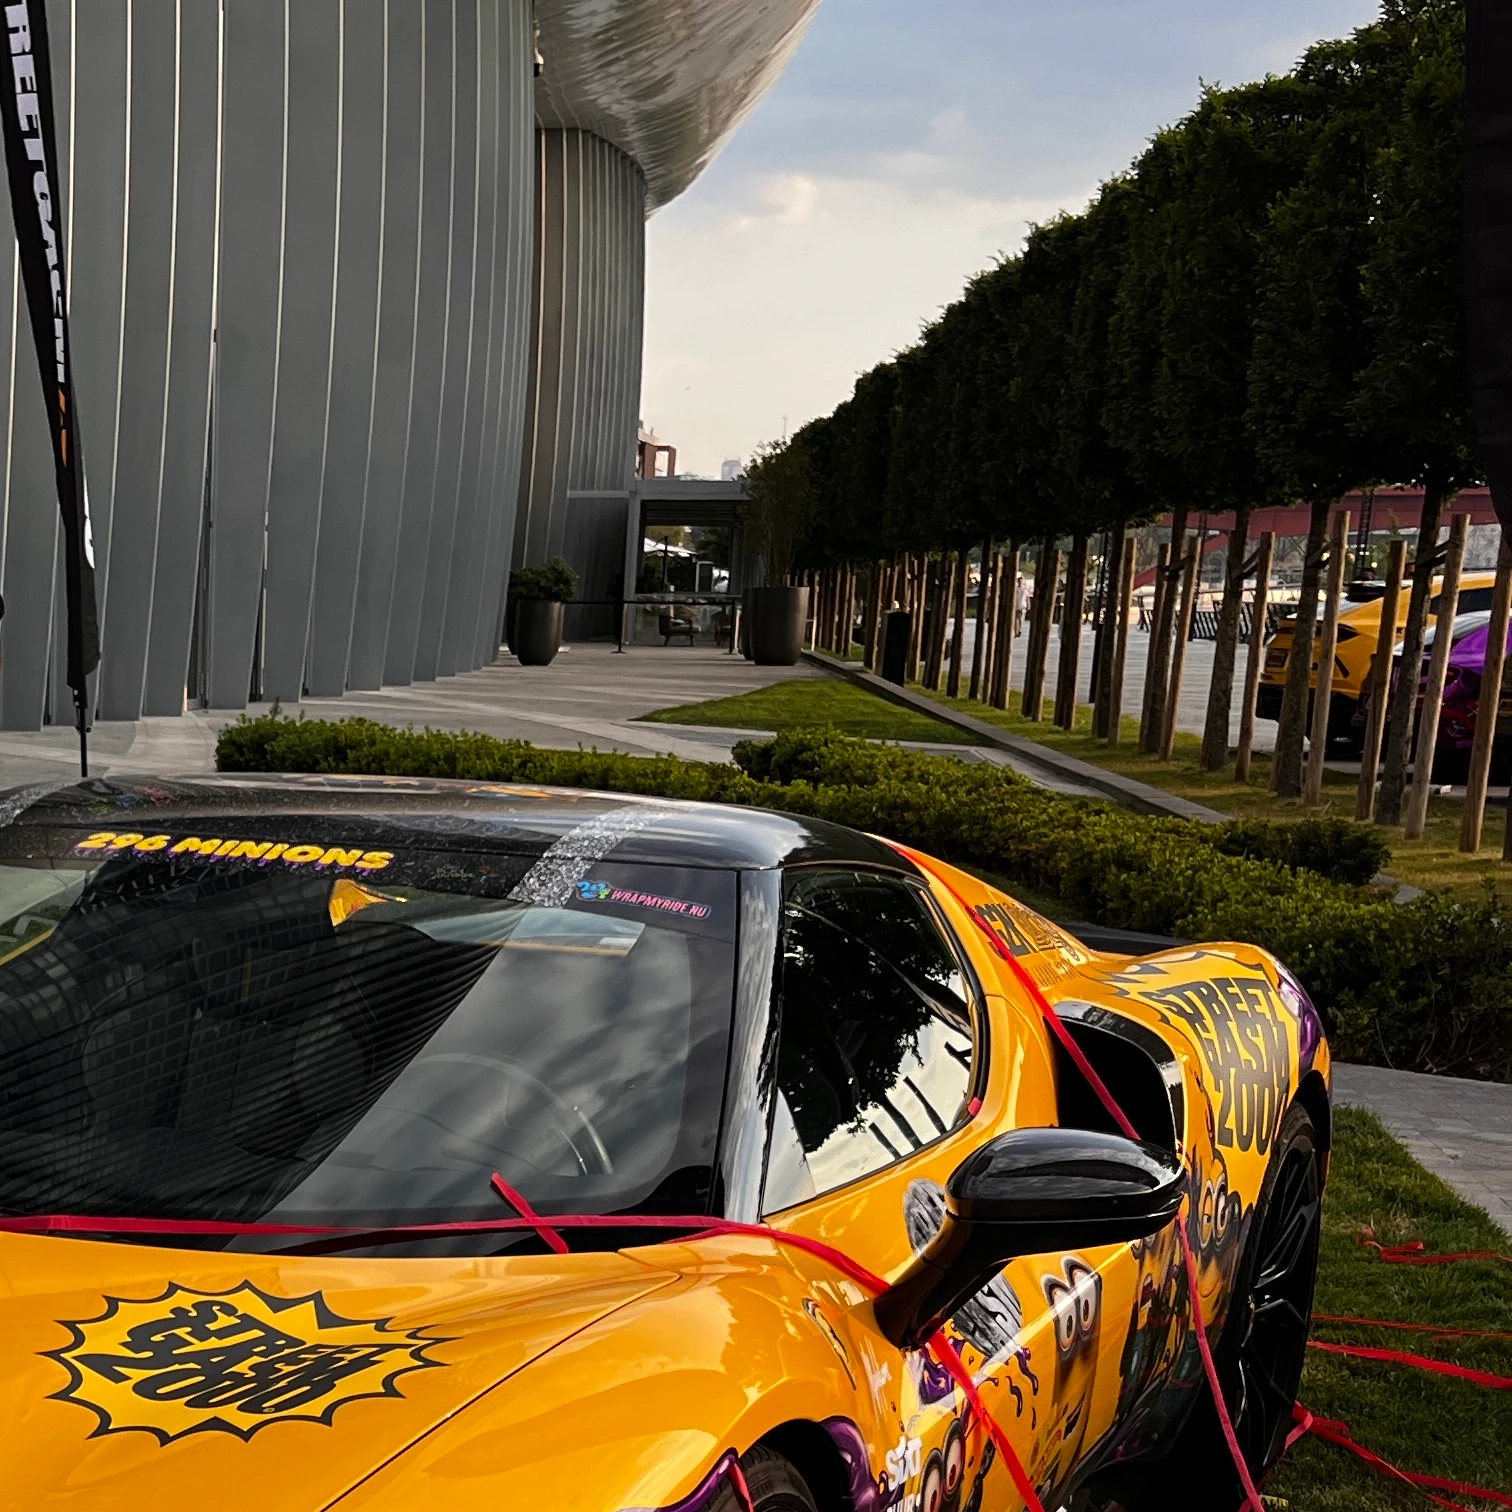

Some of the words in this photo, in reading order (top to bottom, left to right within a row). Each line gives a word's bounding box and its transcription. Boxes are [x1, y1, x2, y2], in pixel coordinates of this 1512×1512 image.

[76, 832, 172, 851] 296
[169, 837, 395, 869] MINIONS
[169, 1300, 422, 1368] STREET
